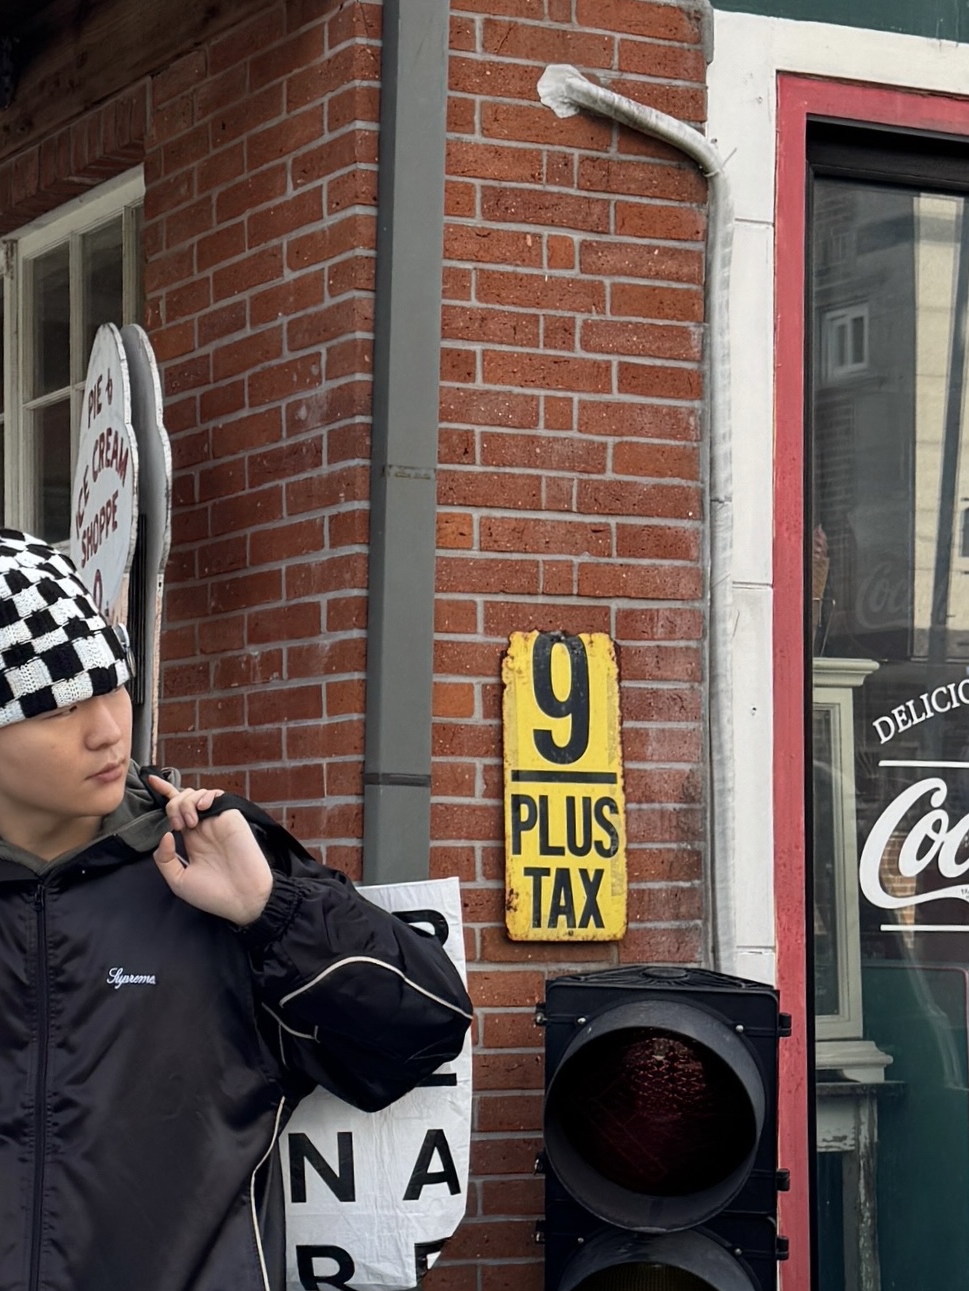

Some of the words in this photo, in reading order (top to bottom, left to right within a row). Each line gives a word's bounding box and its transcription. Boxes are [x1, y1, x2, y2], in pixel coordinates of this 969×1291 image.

[87, 374, 103, 429] PIE
[75, 465, 90, 540] ICE
[91, 427, 129, 487] CREAM
[80, 489, 119, 568] SHOPPE
[532, 633, 590, 765] 9
[510, 794, 620, 858] PLUS
[523, 867, 606, 929] TAX
[106, 967, 156, 989] Supreme
